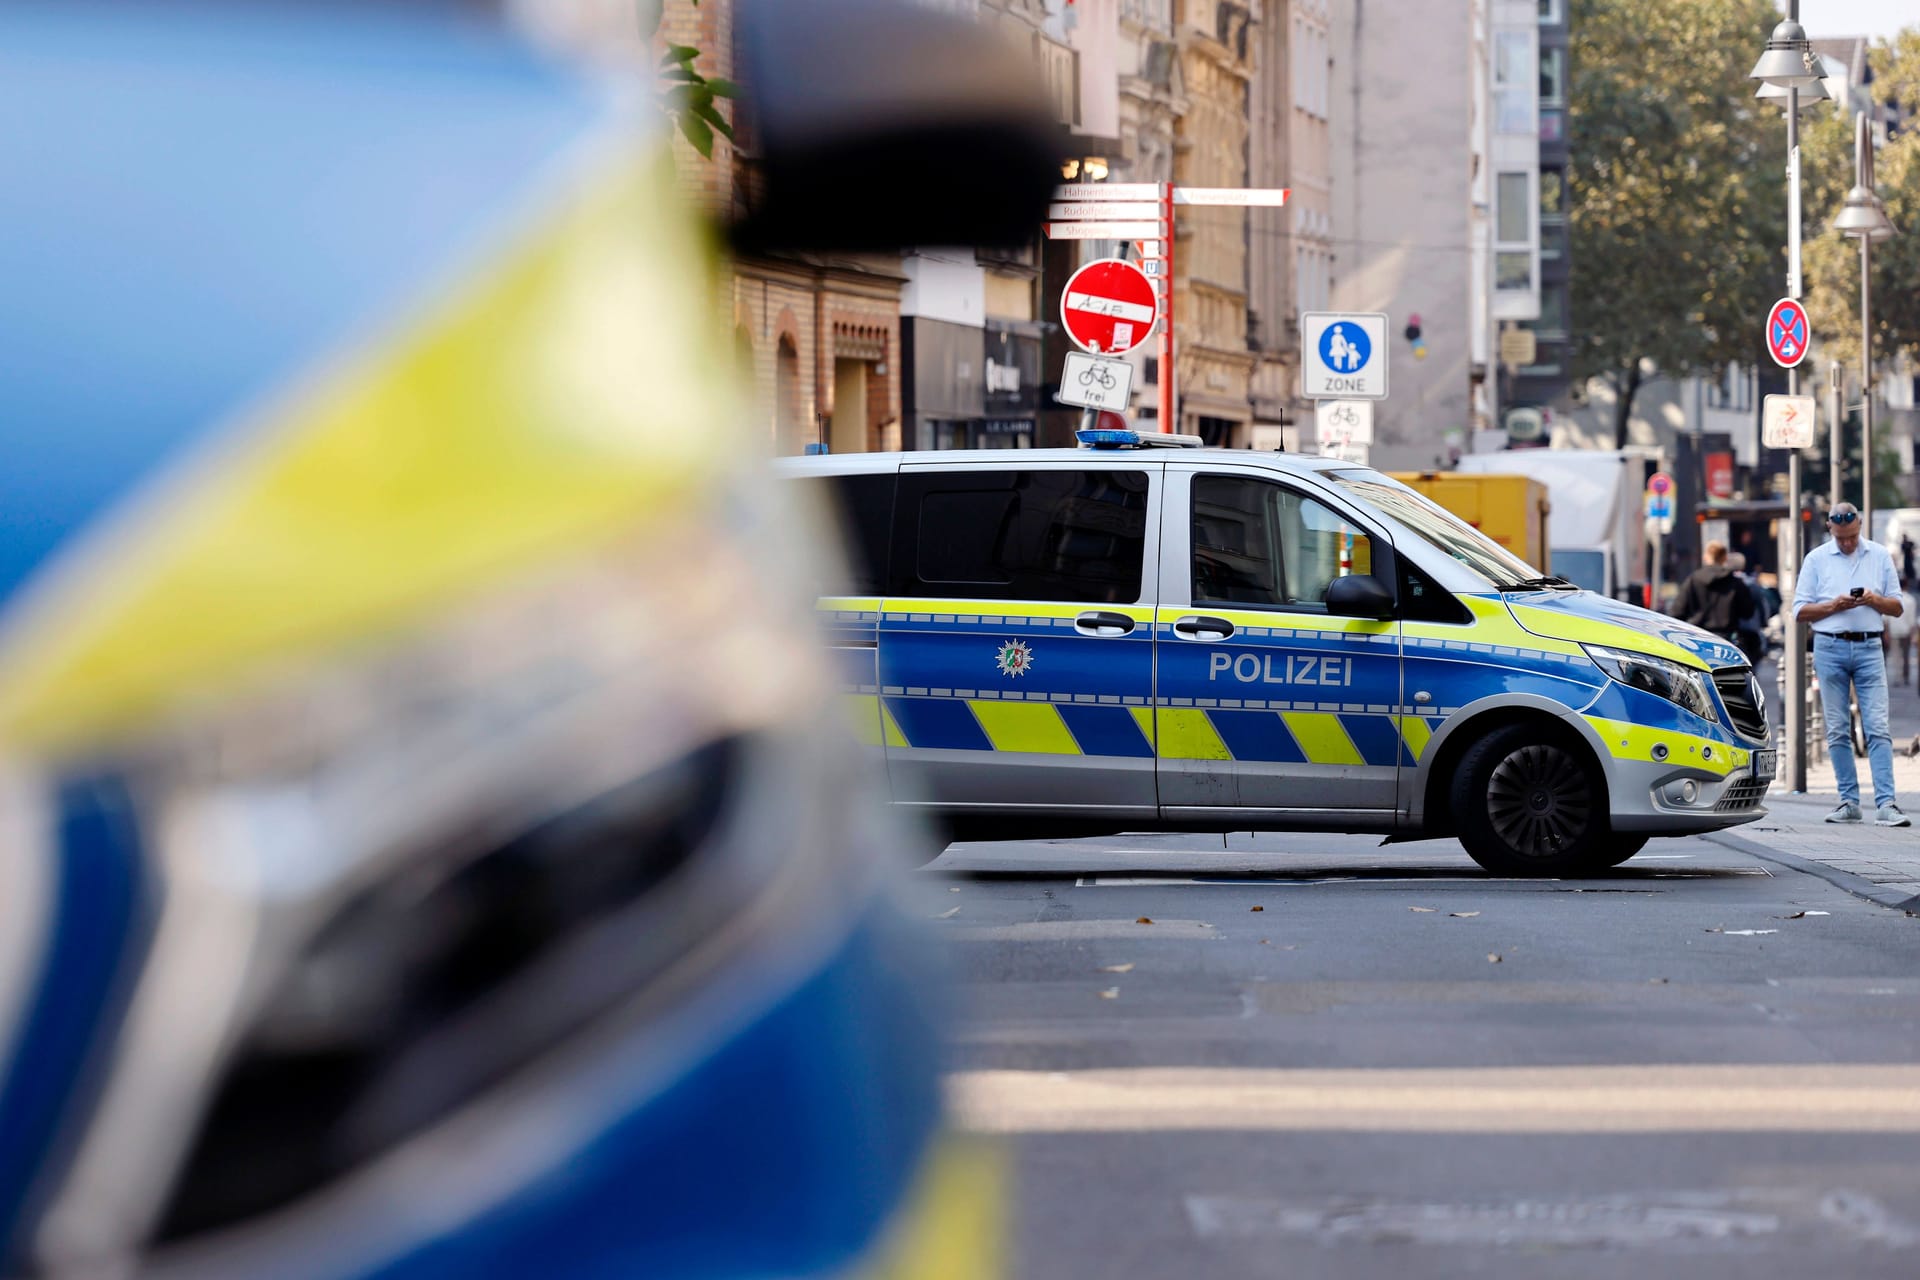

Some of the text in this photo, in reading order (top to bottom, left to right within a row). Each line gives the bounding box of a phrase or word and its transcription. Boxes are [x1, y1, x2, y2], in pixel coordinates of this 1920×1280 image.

[1063, 206, 1118, 218] Rudolfplatz
[1325, 378, 1365, 392] ZONE
[1084, 389, 1106, 403] frei
[1209, 652, 1352, 687] POLIZEI
